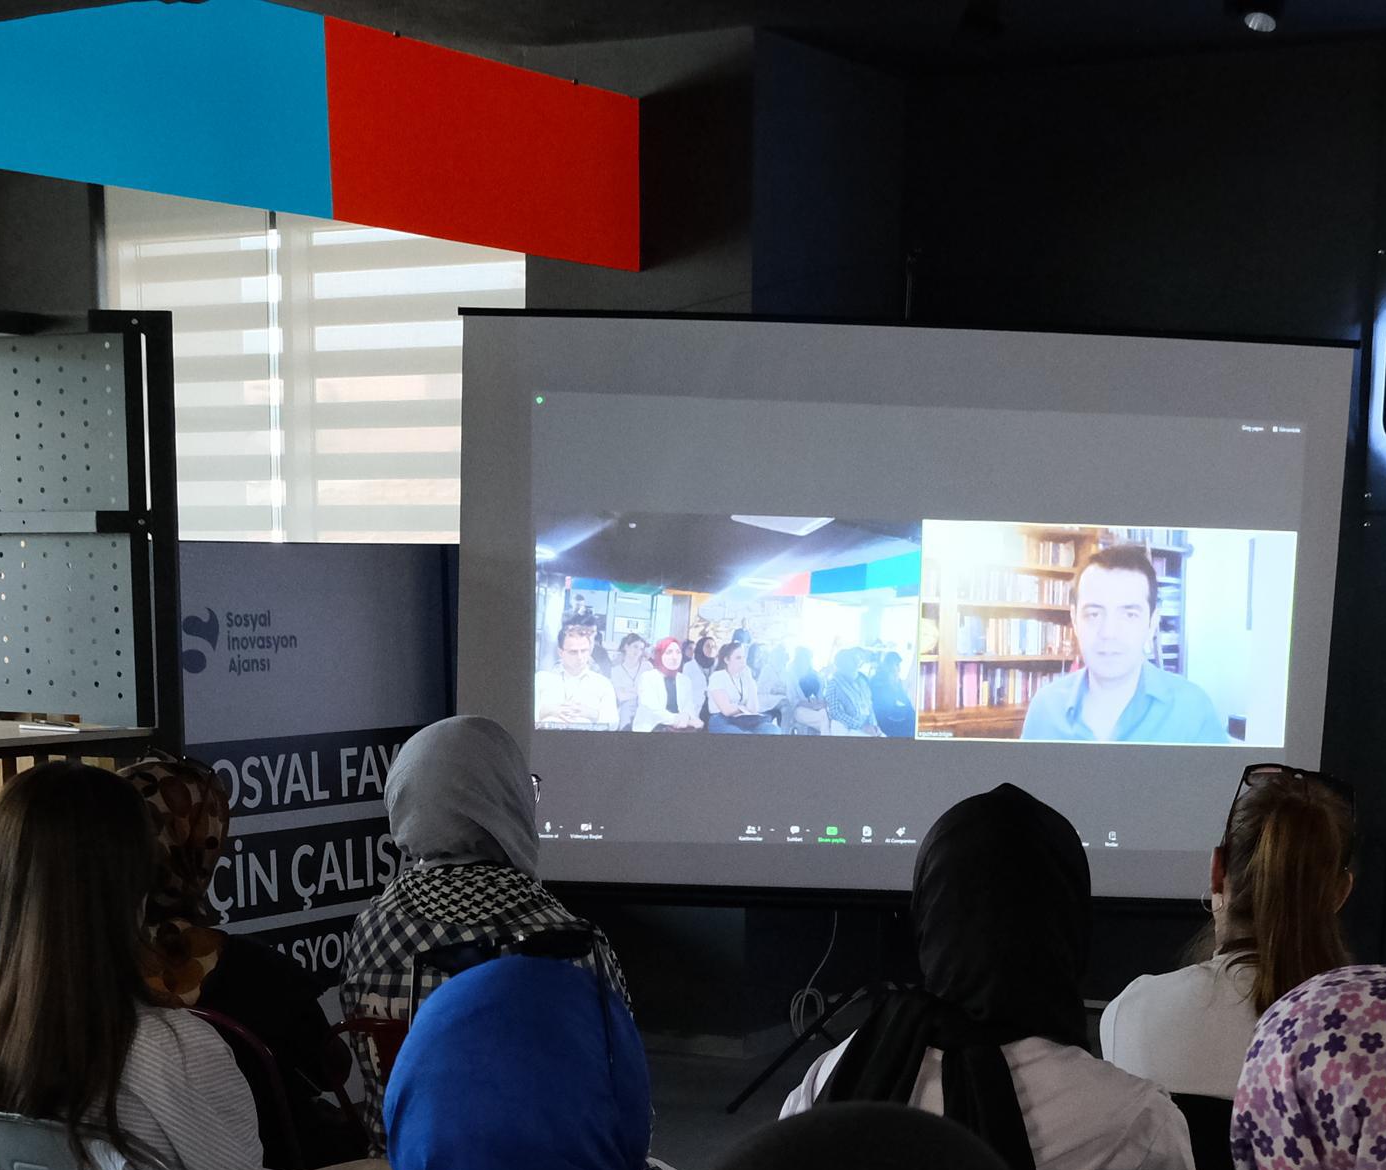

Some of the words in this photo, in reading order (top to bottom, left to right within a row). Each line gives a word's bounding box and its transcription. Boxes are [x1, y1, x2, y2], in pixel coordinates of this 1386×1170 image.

[226, 609, 271, 632] Sosyal
[228, 654, 271, 676] Ajansı
[212, 751, 330, 810] OSYAL
[207, 839, 279, 925] ÇİN
